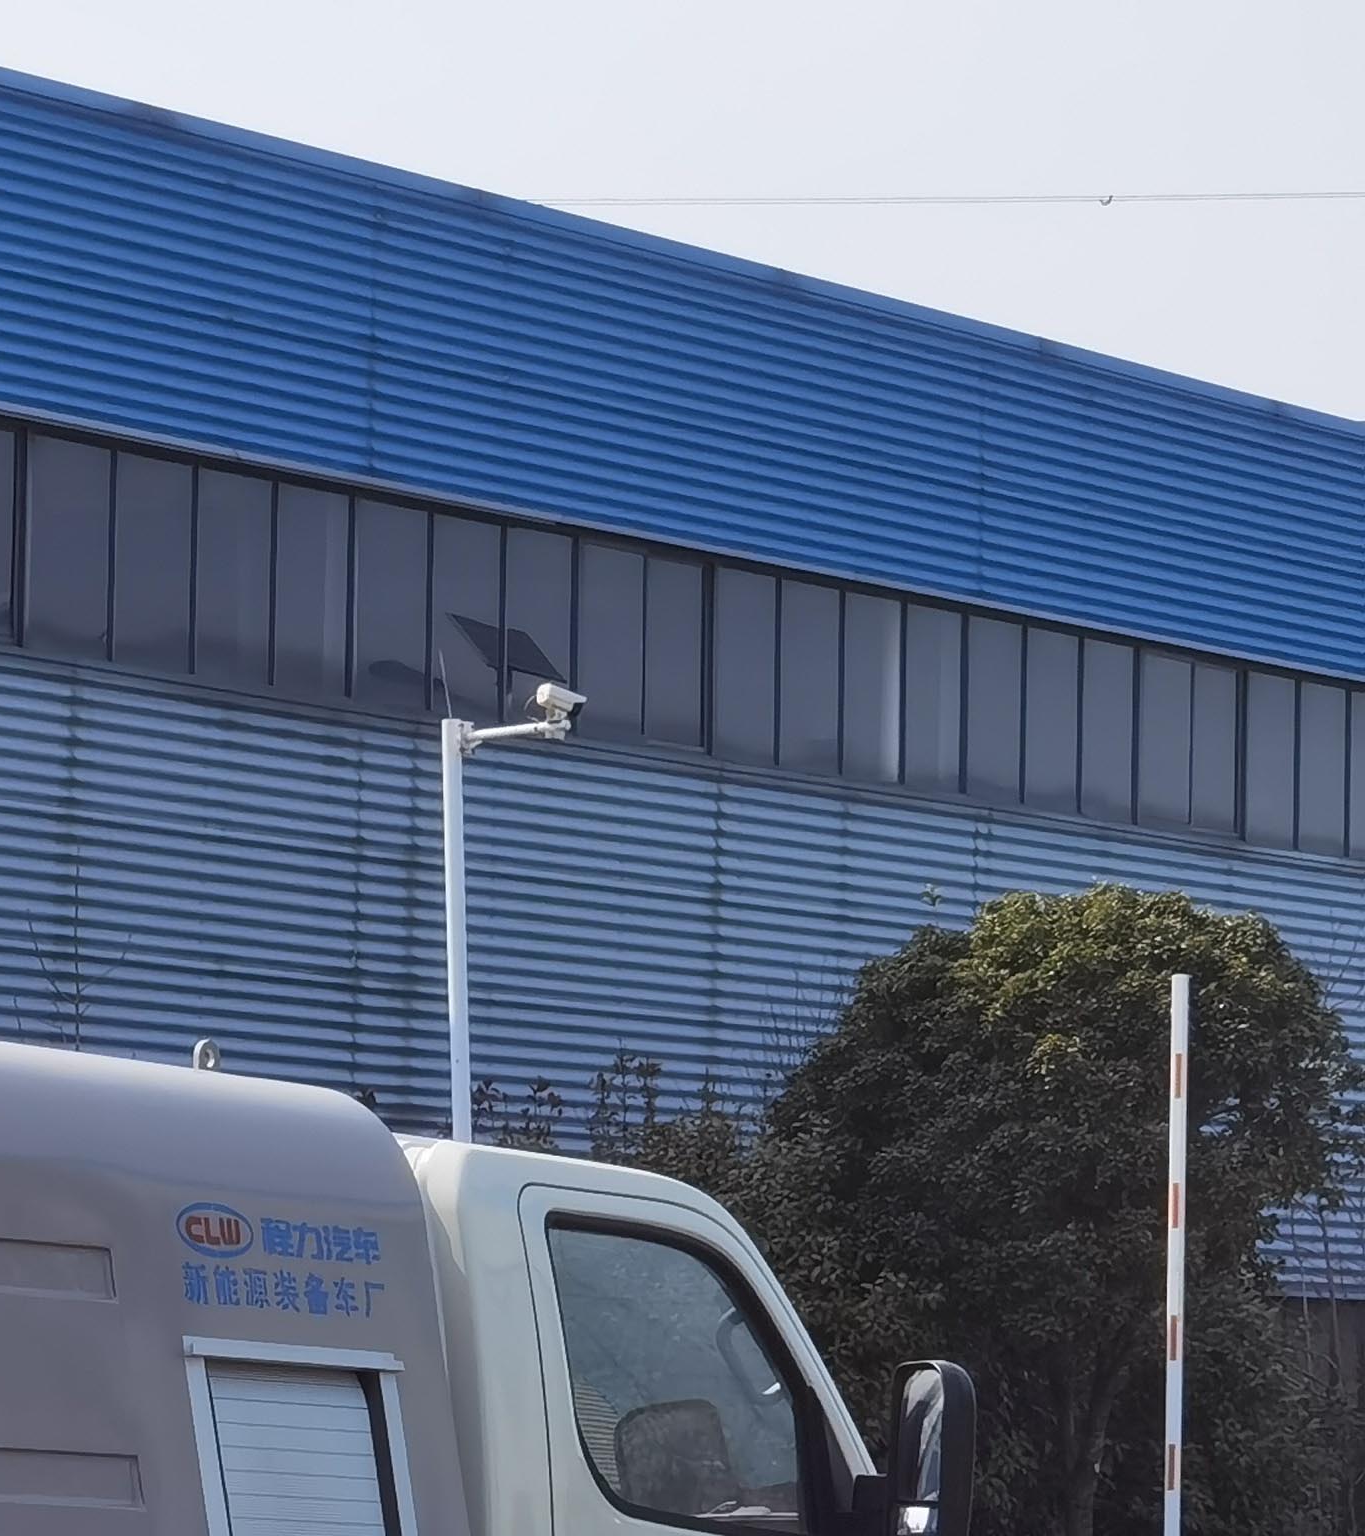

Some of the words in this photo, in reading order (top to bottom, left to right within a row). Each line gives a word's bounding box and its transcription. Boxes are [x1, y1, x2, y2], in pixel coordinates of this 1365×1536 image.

[184, 1215, 242, 1247] CLW
[260, 1217, 382, 1266] 程力汽车
[181, 1261, 385, 1319] 新能源装备车厂
